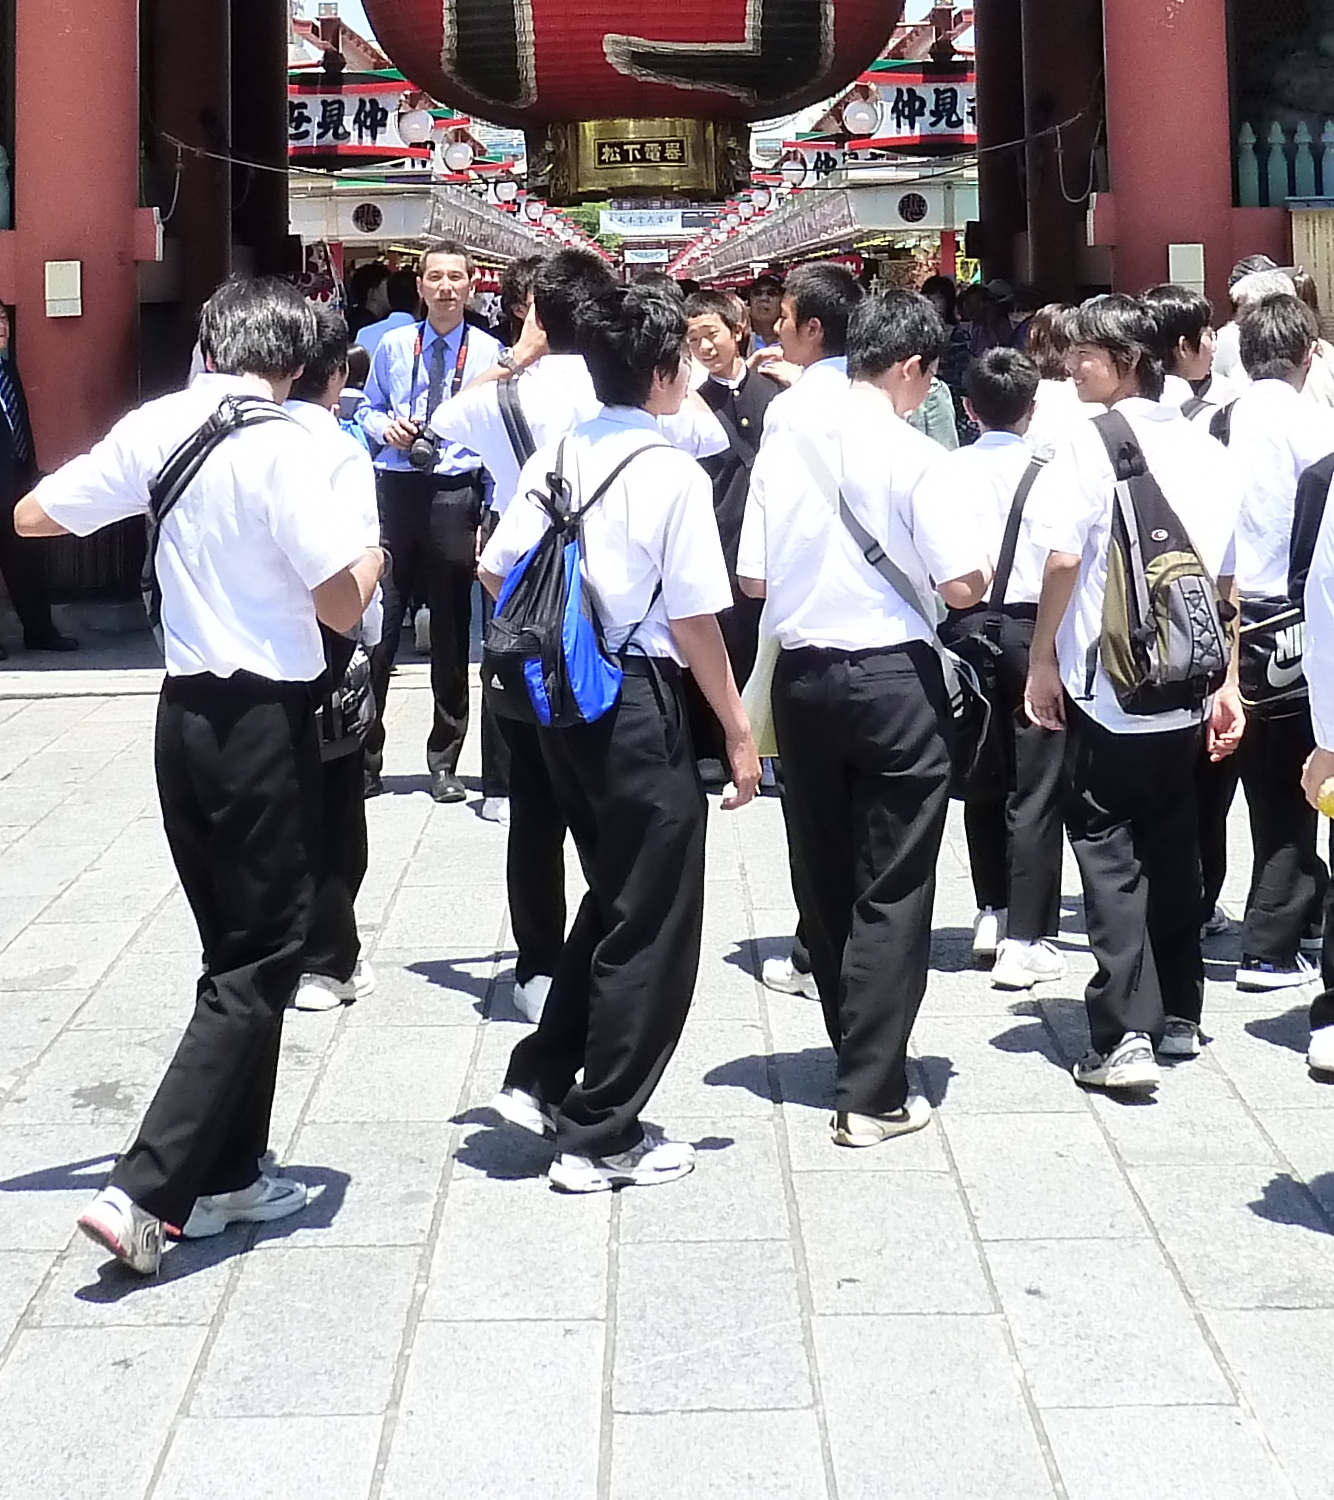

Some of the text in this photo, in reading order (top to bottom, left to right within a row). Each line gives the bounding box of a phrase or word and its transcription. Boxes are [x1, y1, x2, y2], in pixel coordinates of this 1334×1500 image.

[890, 86, 977, 130] 仲見
[600, 142, 683, 163] 松下電器
